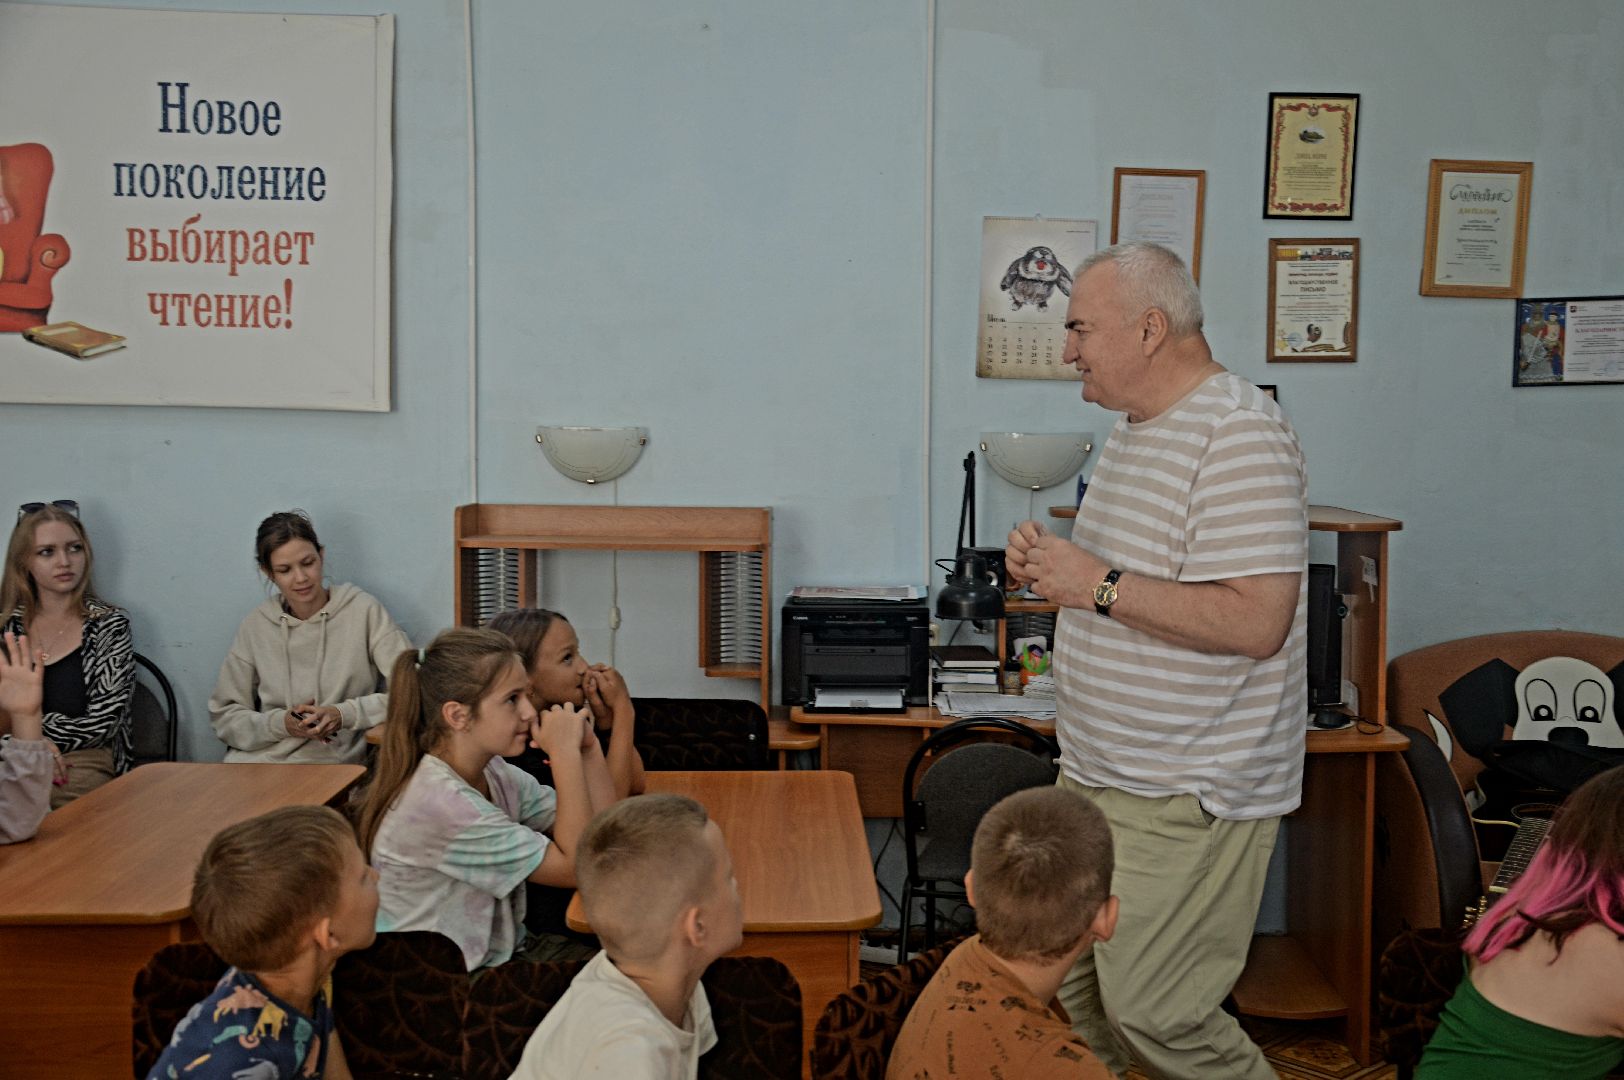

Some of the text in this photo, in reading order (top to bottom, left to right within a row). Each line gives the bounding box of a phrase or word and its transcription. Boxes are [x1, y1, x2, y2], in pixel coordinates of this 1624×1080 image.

[157, 82, 281, 136] Новое
[113, 162, 327, 202] поколение
[126, 213, 315, 276] выбирает
[147, 278, 293, 330] чтение!
